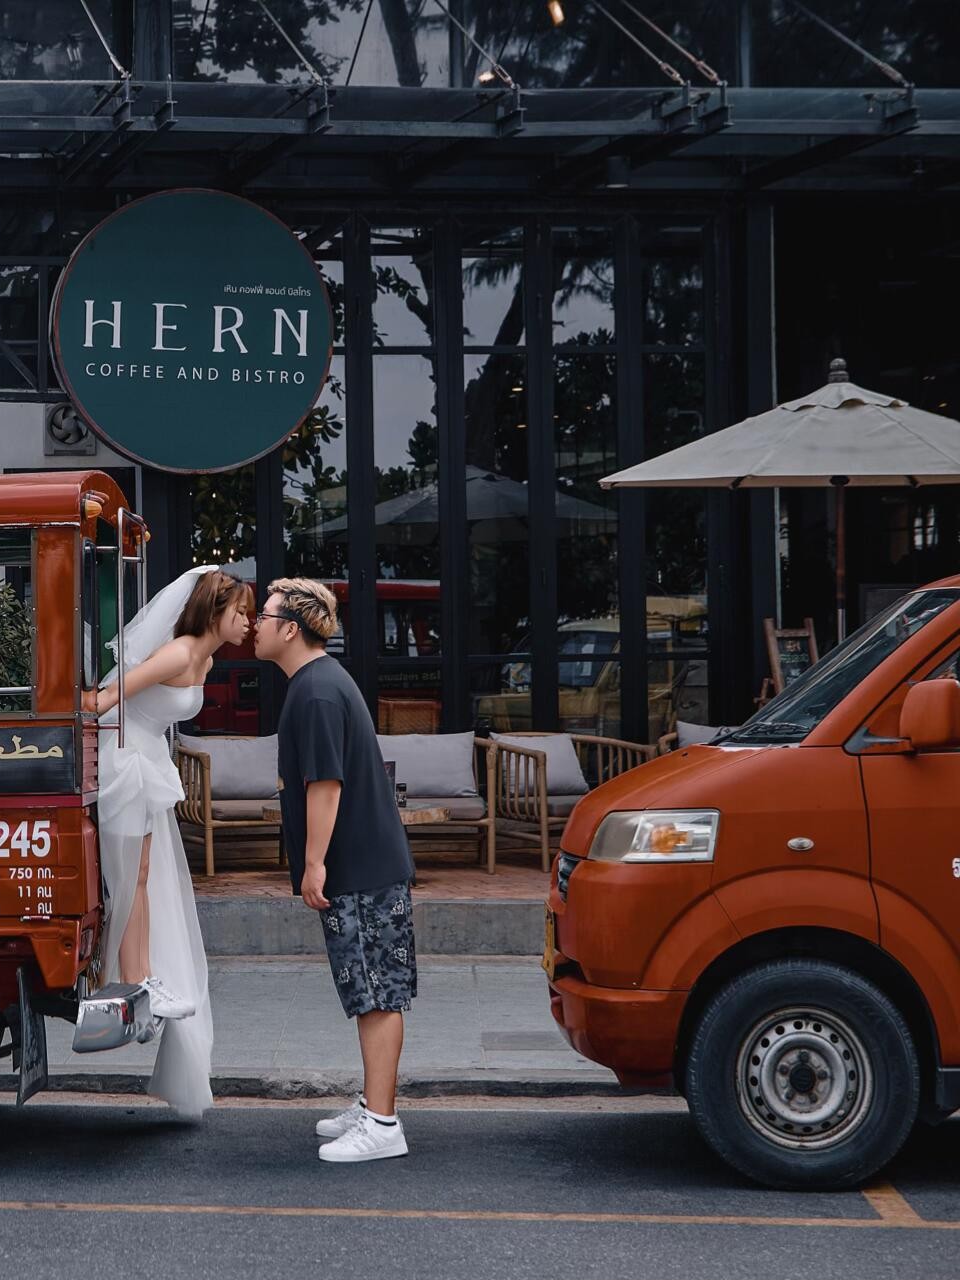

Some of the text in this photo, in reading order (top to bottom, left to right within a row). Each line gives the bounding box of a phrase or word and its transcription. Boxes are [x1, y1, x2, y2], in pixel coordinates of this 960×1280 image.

[83, 299, 309, 357] HERN
[85, 362, 305, 385] COFFEE AND BISTRO
[9, 868, 33, 880] 750
[17, 885, 32, 898] 11
[37, 886, 53, 898] คน
[37, 901, 53, 914] คน
